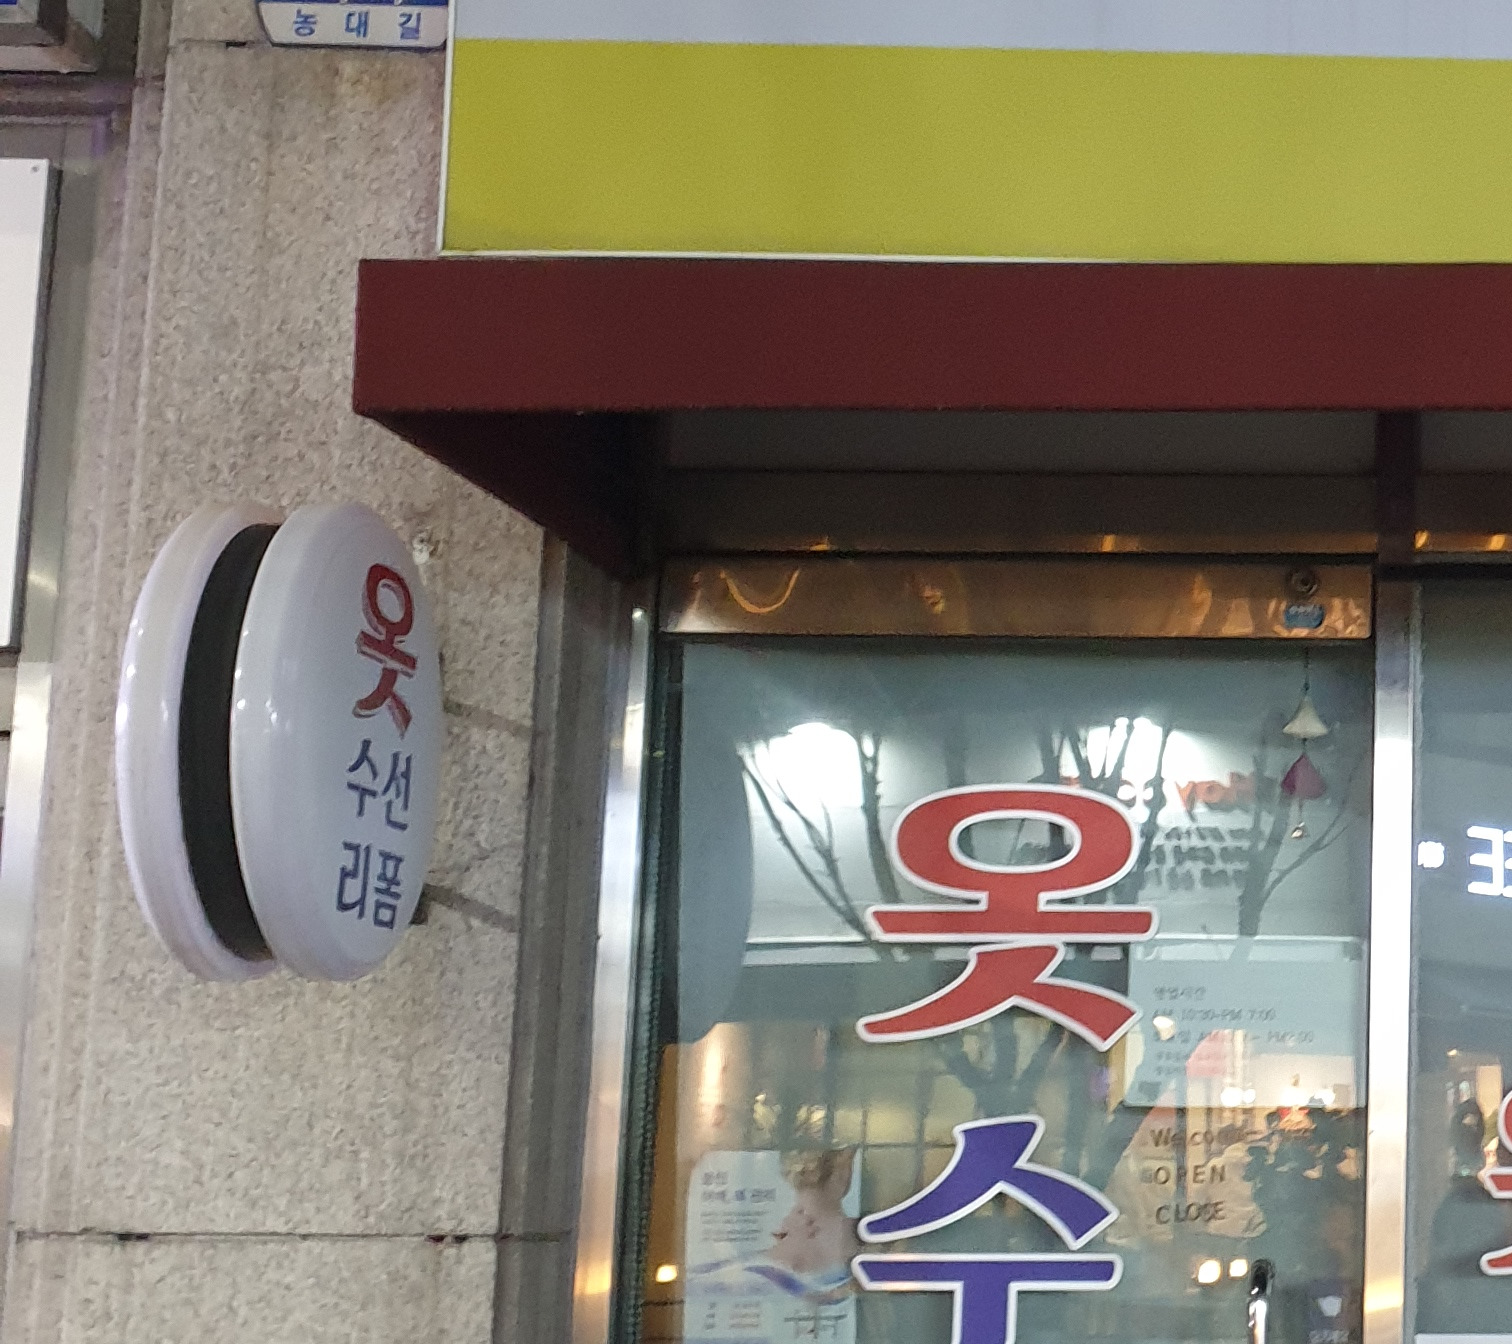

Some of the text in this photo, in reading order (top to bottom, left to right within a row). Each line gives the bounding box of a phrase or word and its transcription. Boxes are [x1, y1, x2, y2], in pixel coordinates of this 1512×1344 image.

[292, 8, 422, 40] 농대길
[352, 562, 419, 740] 옷
[346, 738, 413, 833] 수선
[335, 840, 404, 930] 리폼
